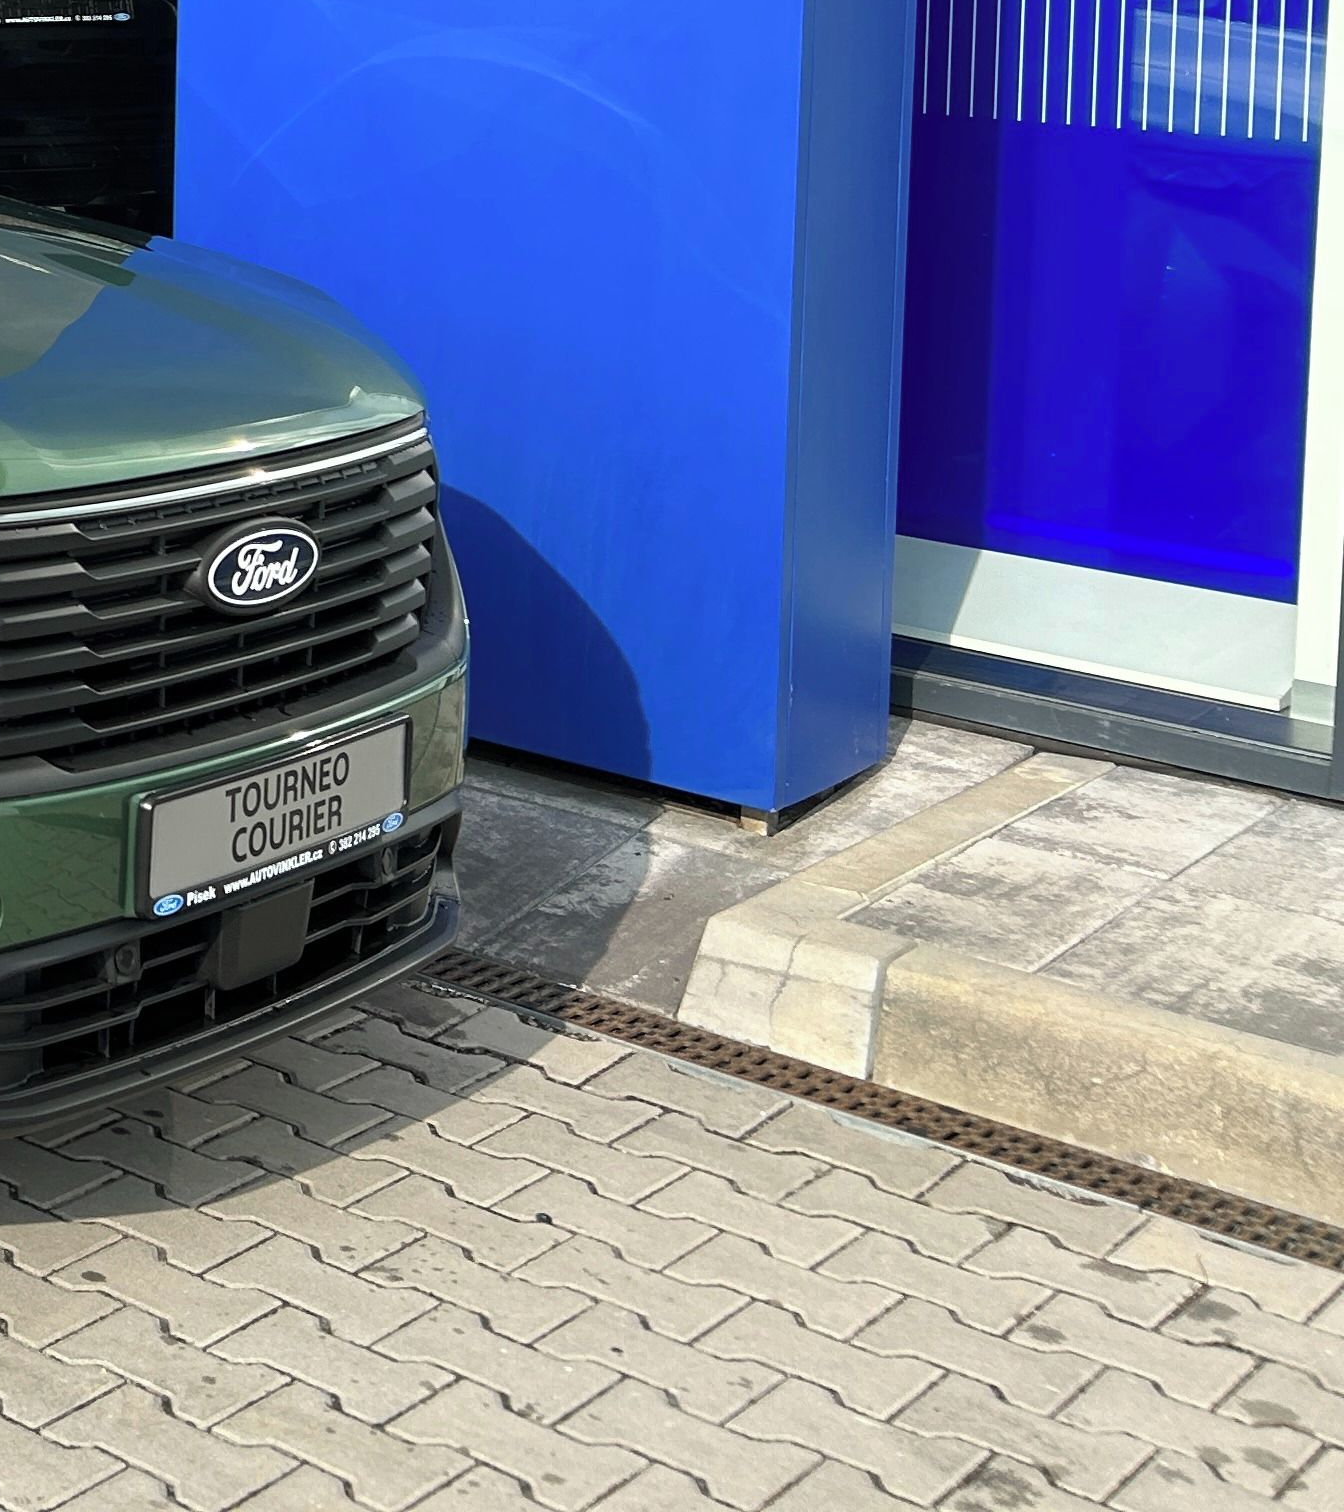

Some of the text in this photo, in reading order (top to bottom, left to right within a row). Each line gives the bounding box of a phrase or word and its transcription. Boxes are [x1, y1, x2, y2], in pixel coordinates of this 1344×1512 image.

[232, 539, 300, 596] Ford
[225, 751, 350, 823] TOURNEO
[231, 794, 343, 863] COURIER
